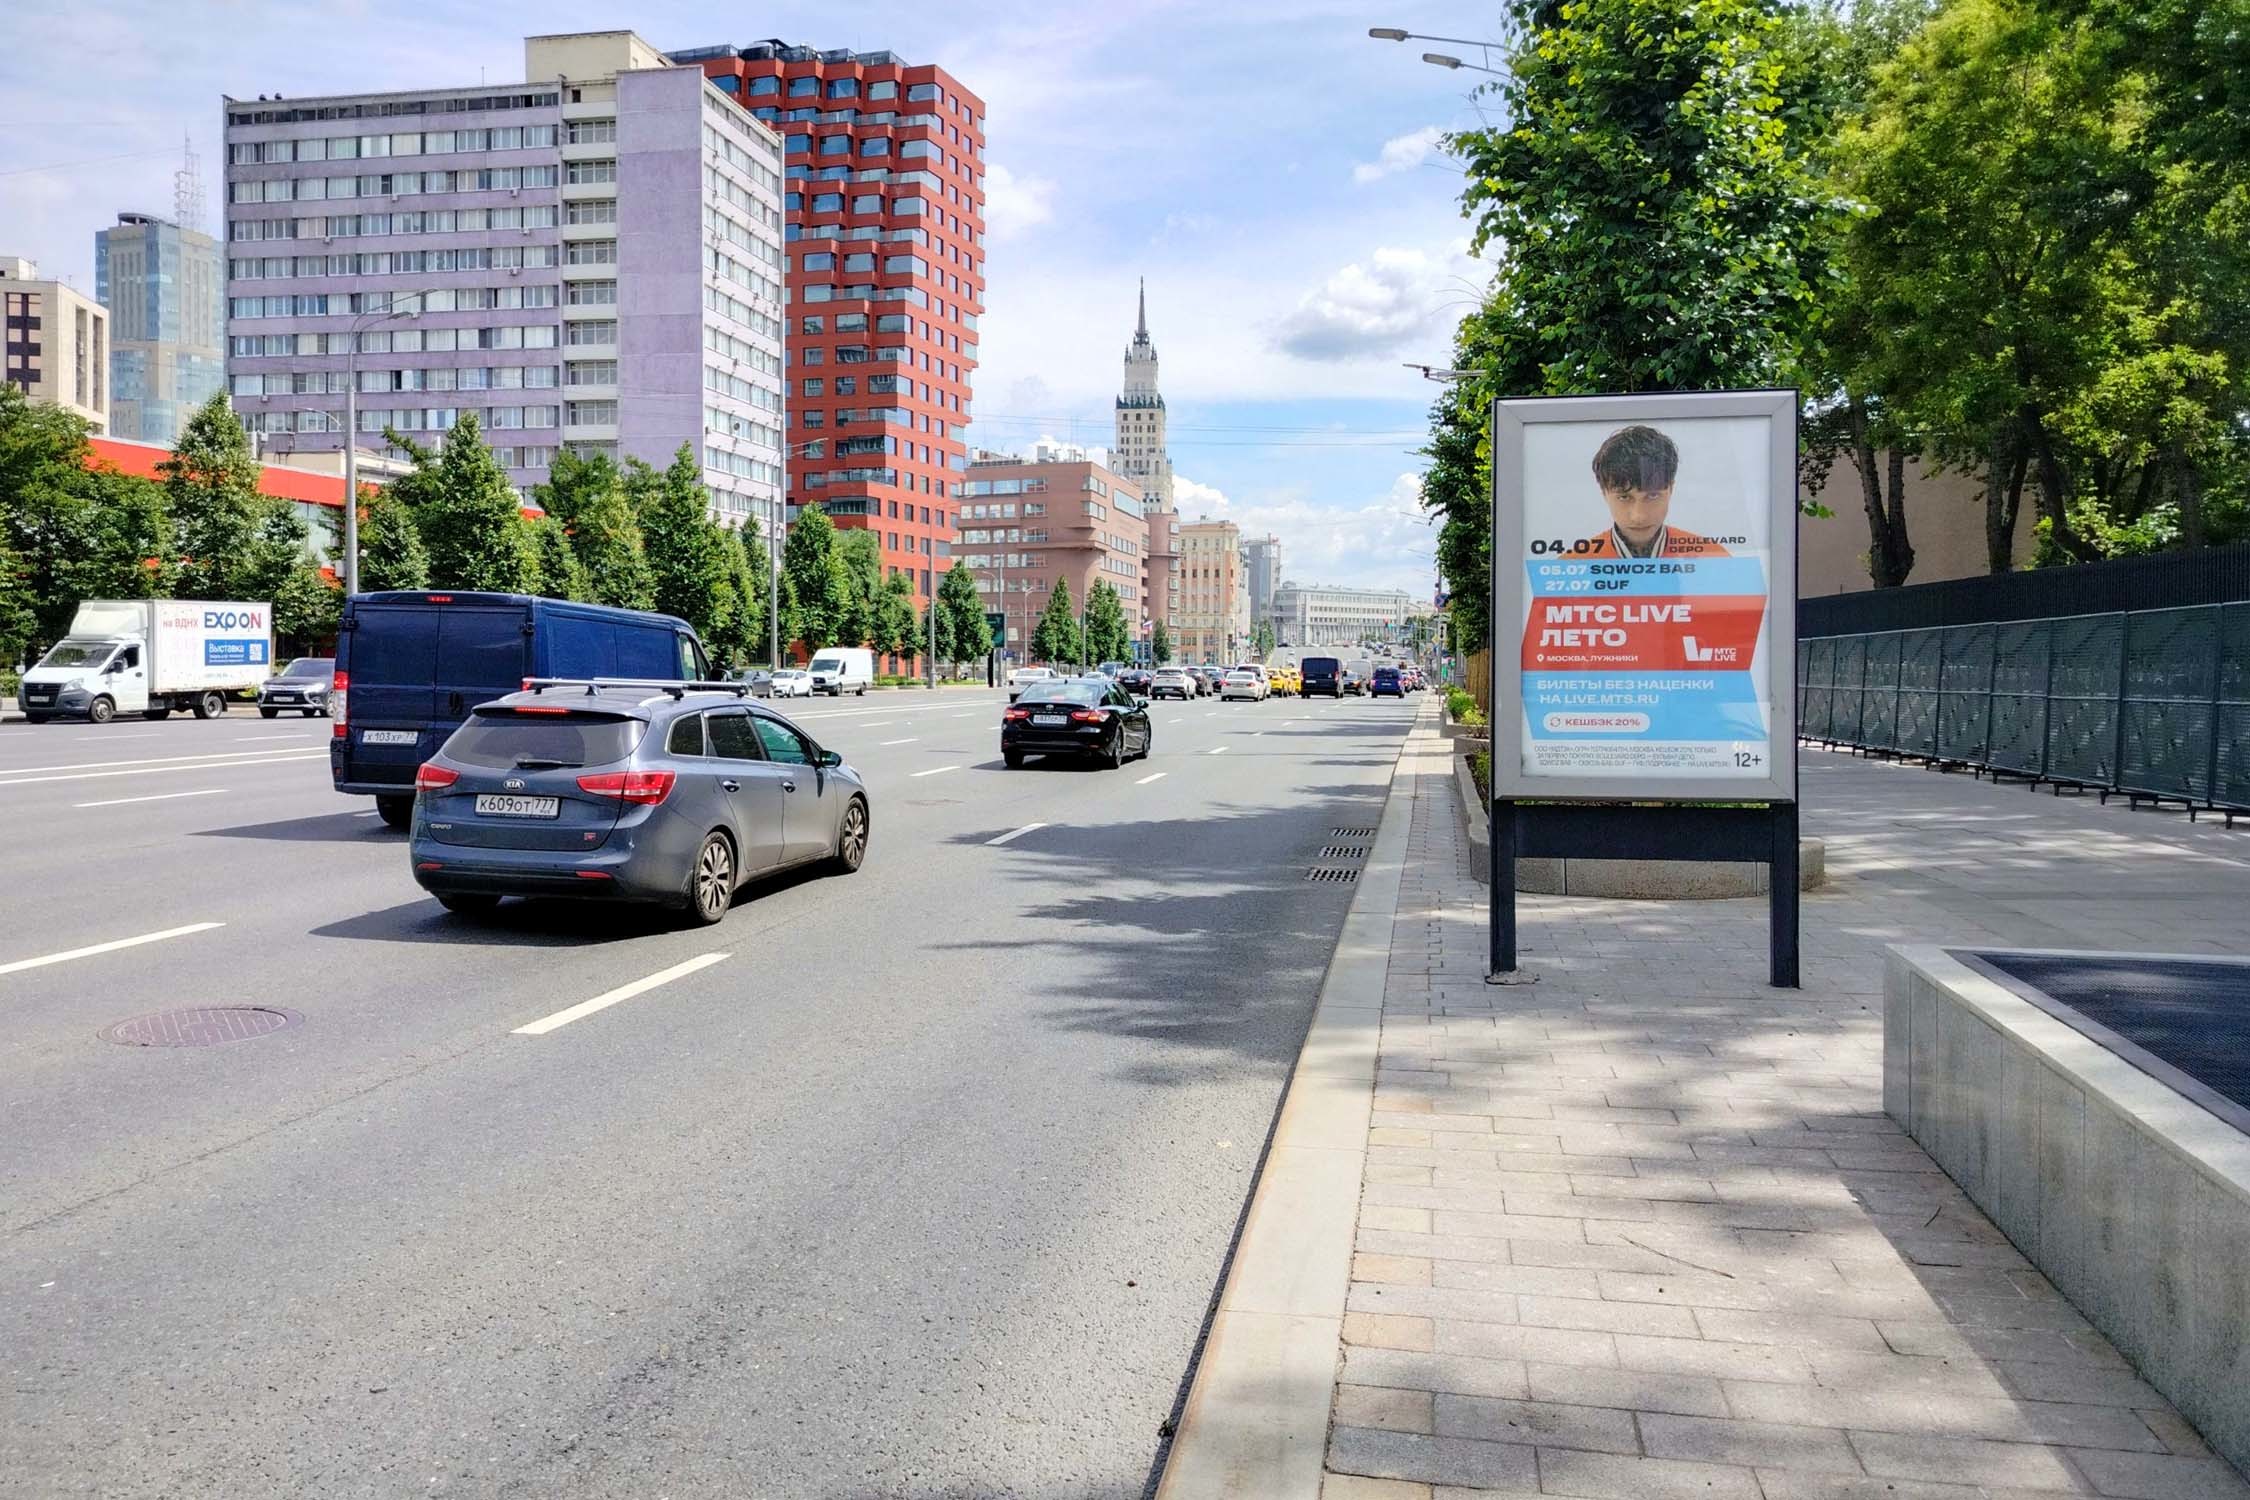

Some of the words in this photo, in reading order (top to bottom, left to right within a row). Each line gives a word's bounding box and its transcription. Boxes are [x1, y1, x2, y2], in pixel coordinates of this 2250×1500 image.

[1669, 536, 1747, 545] BOULEVARD
[1531, 539, 1605, 554] 04.07
[1669, 545, 1704, 554] DEPO
[1539, 564, 1587, 576] 05.07
[1590, 564, 1656, 576] SQWOZ
[1659, 563, 1697, 574] BAB
[1545, 580, 1591, 591] 27.07
[1593, 580, 1630, 591] GUF
[1545, 604, 1617, 624] МТС
[1622, 604, 1692, 623] LIVE
[175, 618, 199, 630] ВДНХ
[1539, 628, 1627, 647] ЛЕТО
[208, 643, 245, 654] Выставка
[1714, 647, 1737, 655] МТС
[1546, 655, 1588, 663] МОСКВА,
[1714, 654, 1737, 662] LIVE
[1536, 679, 1601, 691] БИЛЕТЫ
[1604, 679, 1634, 690] БЕЗ
[1637, 679, 1714, 692] НАЦЕНКИ
[1539, 694, 1561, 704] НА
[1564, 693, 1660, 705] LIVE.MTS.RU
[1565, 717, 1613, 727] КЕШБЭК
[1615, 717, 1641, 726] 20%
[1733, 752, 1762, 767] 12+
[535, 798, 555, 809] 777
